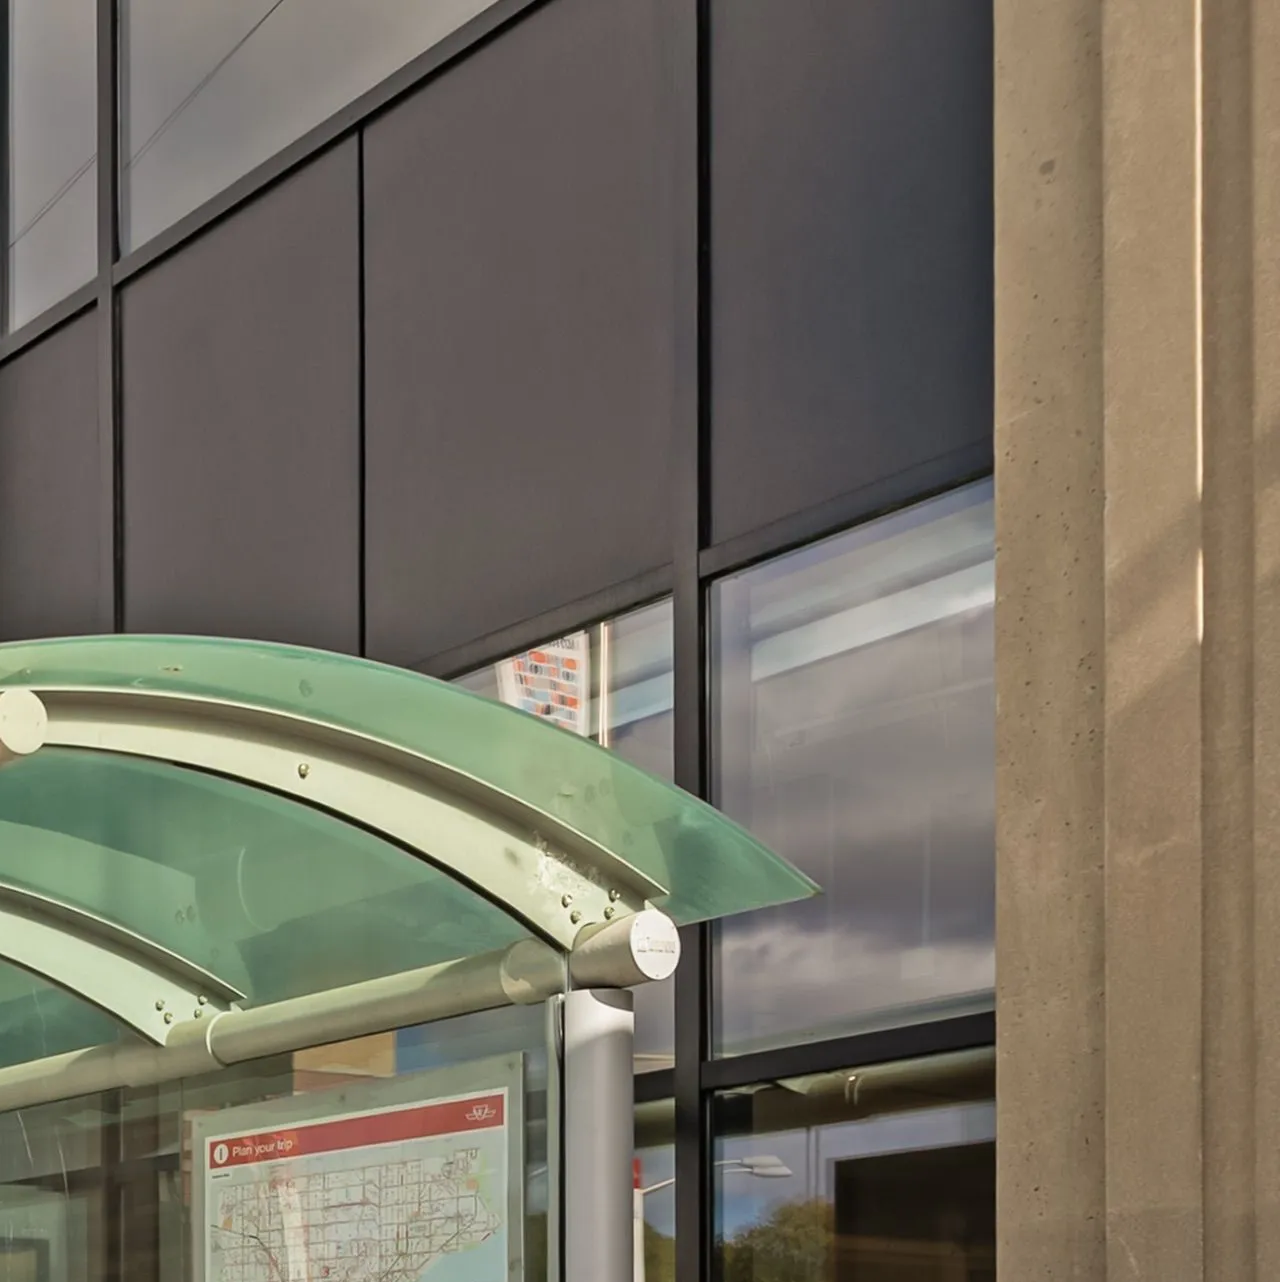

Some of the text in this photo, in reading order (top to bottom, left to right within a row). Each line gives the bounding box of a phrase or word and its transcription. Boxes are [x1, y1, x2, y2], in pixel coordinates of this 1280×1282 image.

[232, 1139, 294, 1157] Plan your trip
